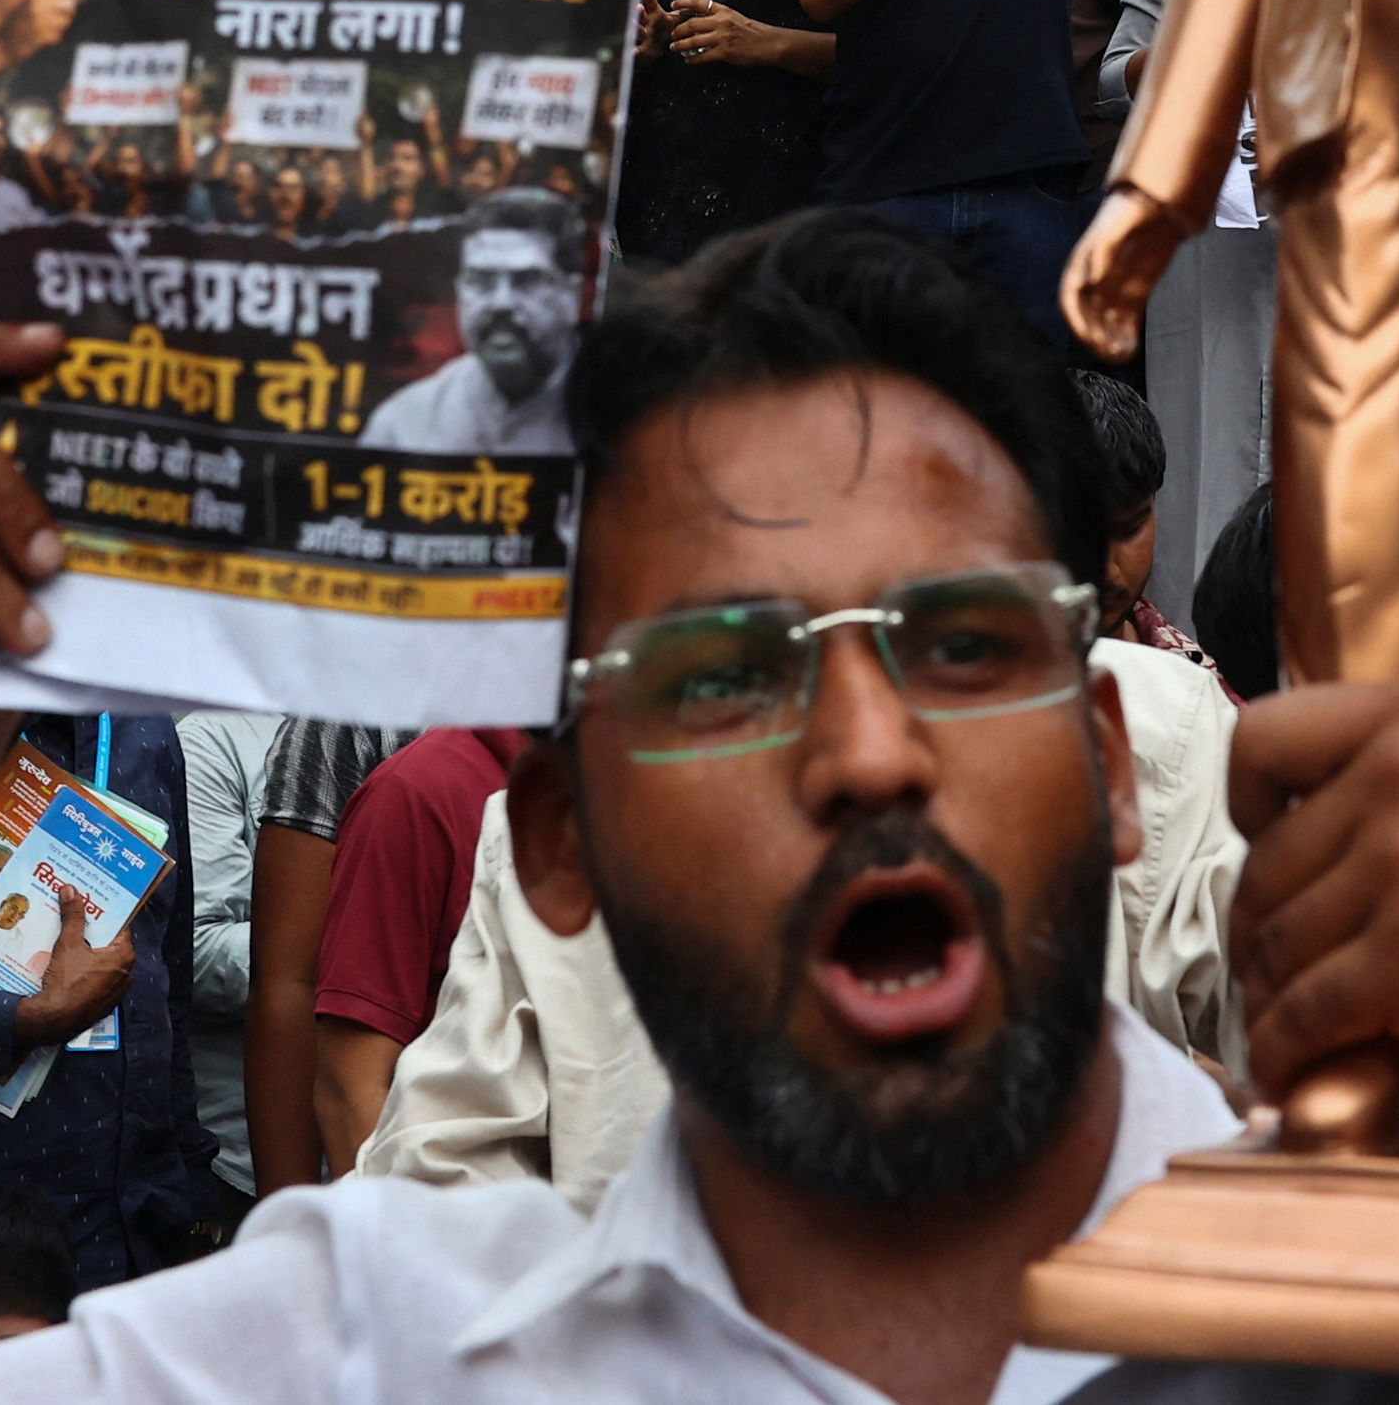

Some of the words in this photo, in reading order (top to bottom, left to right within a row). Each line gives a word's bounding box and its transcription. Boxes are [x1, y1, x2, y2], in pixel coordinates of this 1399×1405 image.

[191, 260, 382, 342] प्रधान
[254, 339, 367, 435] दो!
[303, 458, 386, 520] 1-1
[398, 455, 534, 535] करोड़
